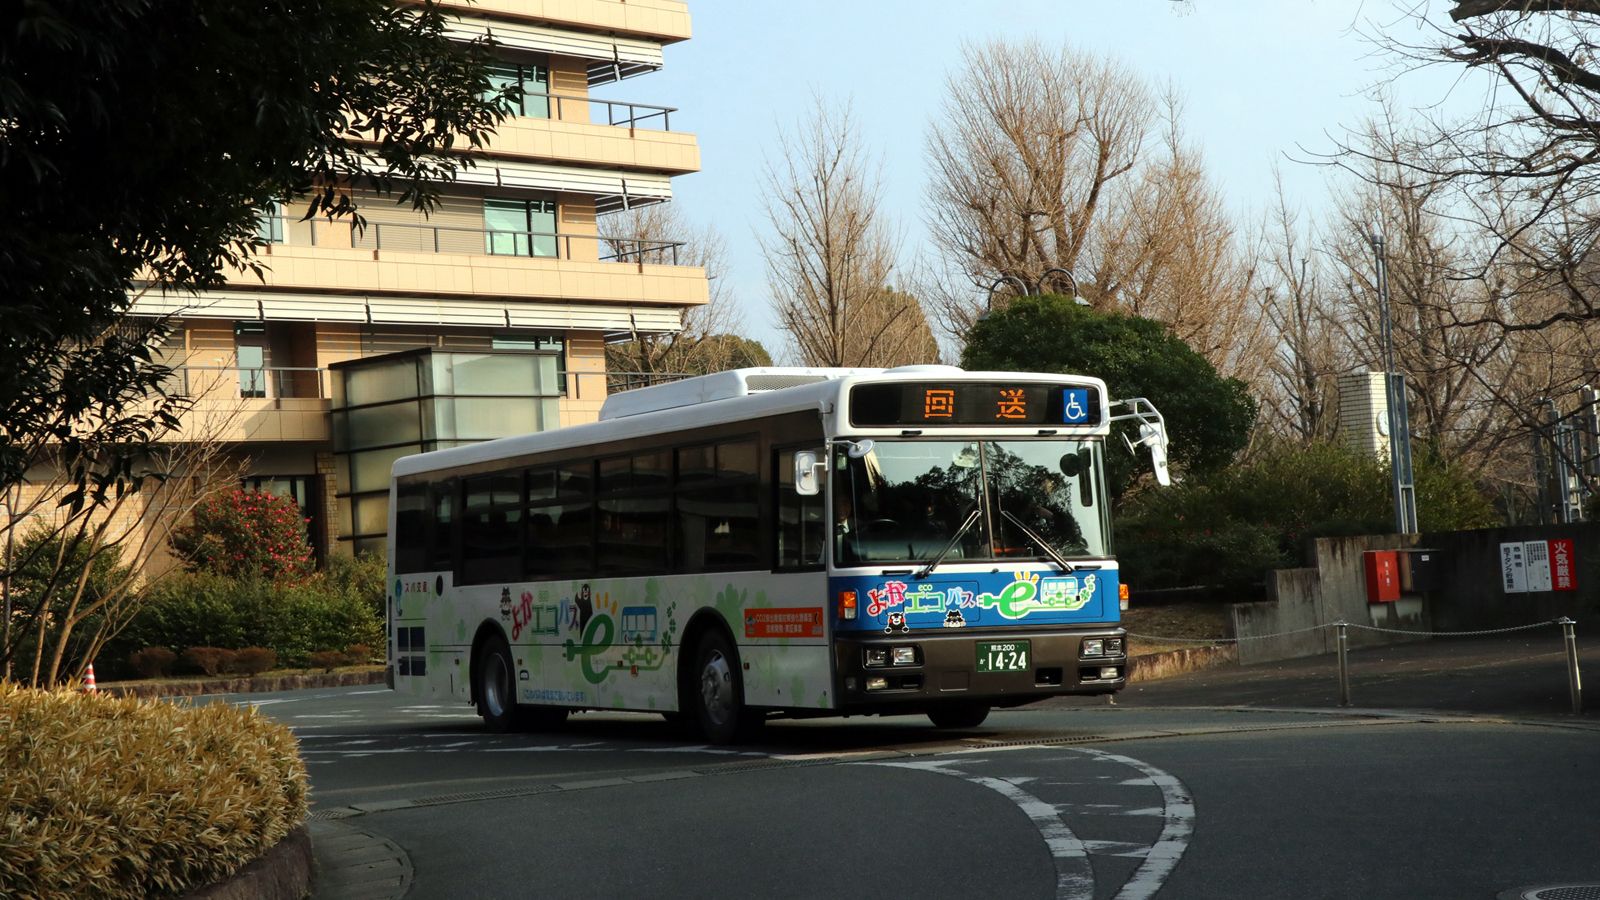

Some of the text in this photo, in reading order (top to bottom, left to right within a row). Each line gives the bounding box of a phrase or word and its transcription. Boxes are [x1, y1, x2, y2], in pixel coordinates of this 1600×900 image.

[924, 389, 1026, 419] 回送
[1554, 542, 1571, 588] 火気厳禁
[988, 651, 1027, 671] 14-24
